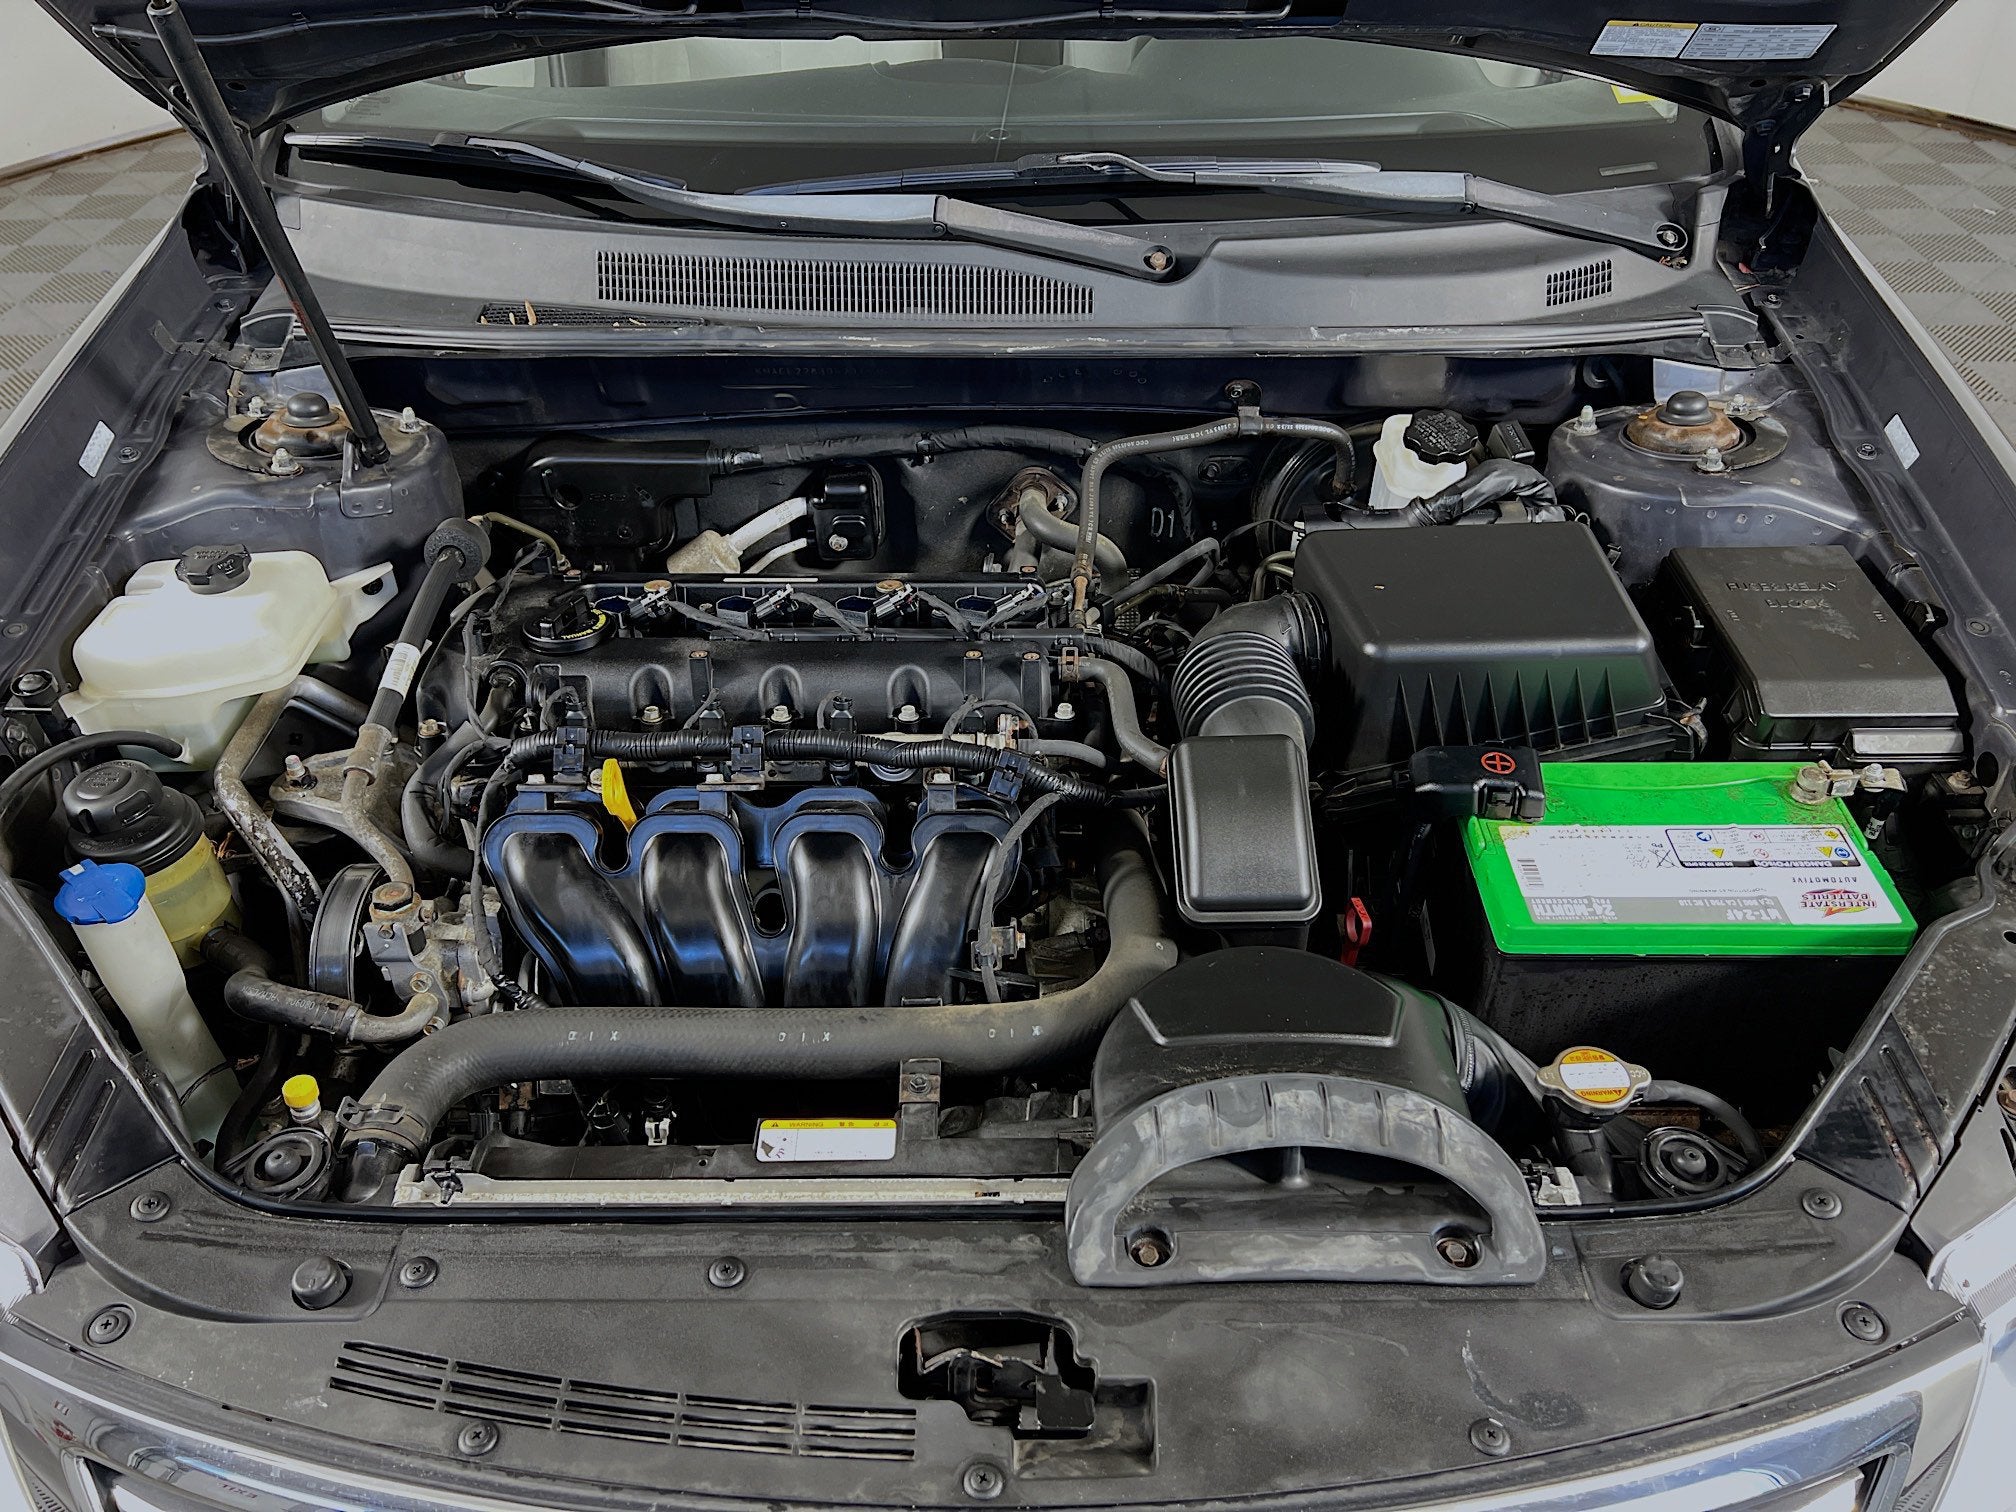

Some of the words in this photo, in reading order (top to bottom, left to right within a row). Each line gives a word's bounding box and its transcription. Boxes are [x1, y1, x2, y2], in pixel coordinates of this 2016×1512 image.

[1151, 507, 1175, 538] D1
[1764, 599, 1830, 609] BLOCK
[1532, 903, 1616, 916] 24-MONTH
[1580, 1089, 1614, 1097] WARNING
